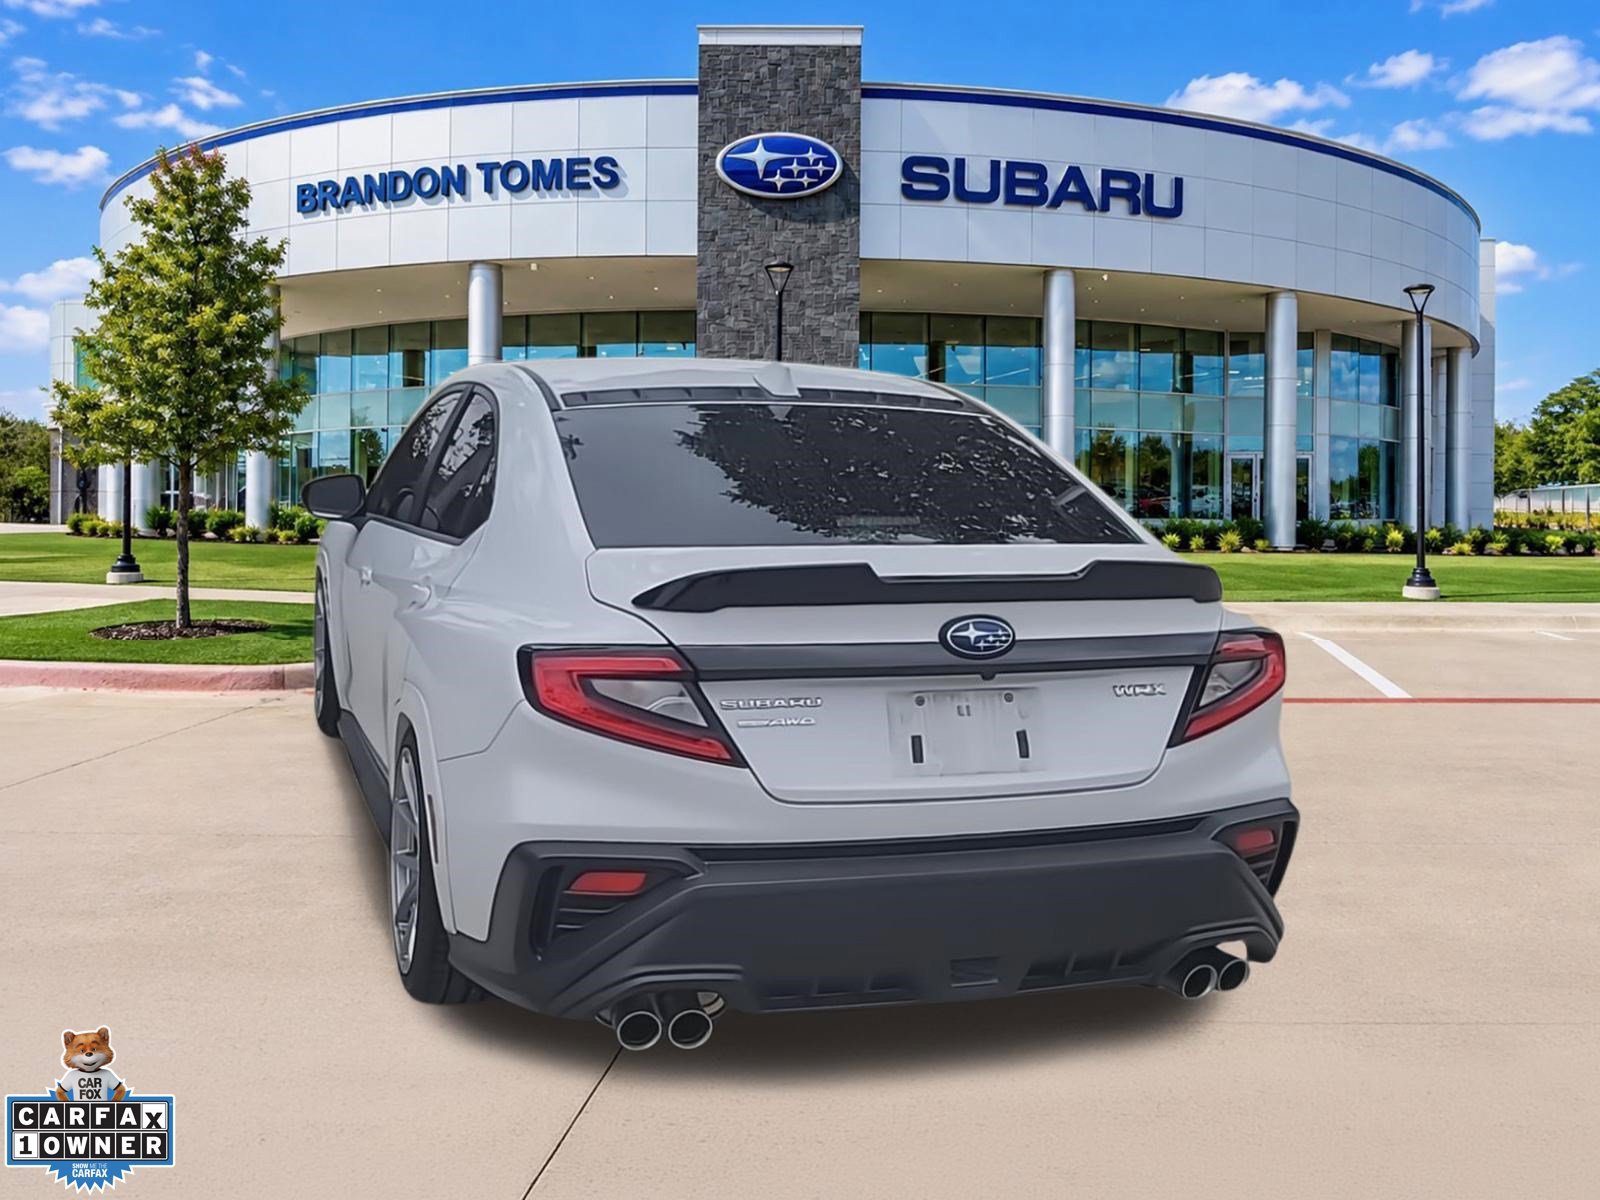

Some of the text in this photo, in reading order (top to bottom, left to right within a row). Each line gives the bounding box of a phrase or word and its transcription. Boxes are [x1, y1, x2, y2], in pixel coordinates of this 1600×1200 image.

[296, 156, 620, 214] BRANDON TOMES
[900, 155, 1183, 218] SUBARU
[720, 697, 822, 710] SUBARU
[1112, 683, 1167, 697] WRX
